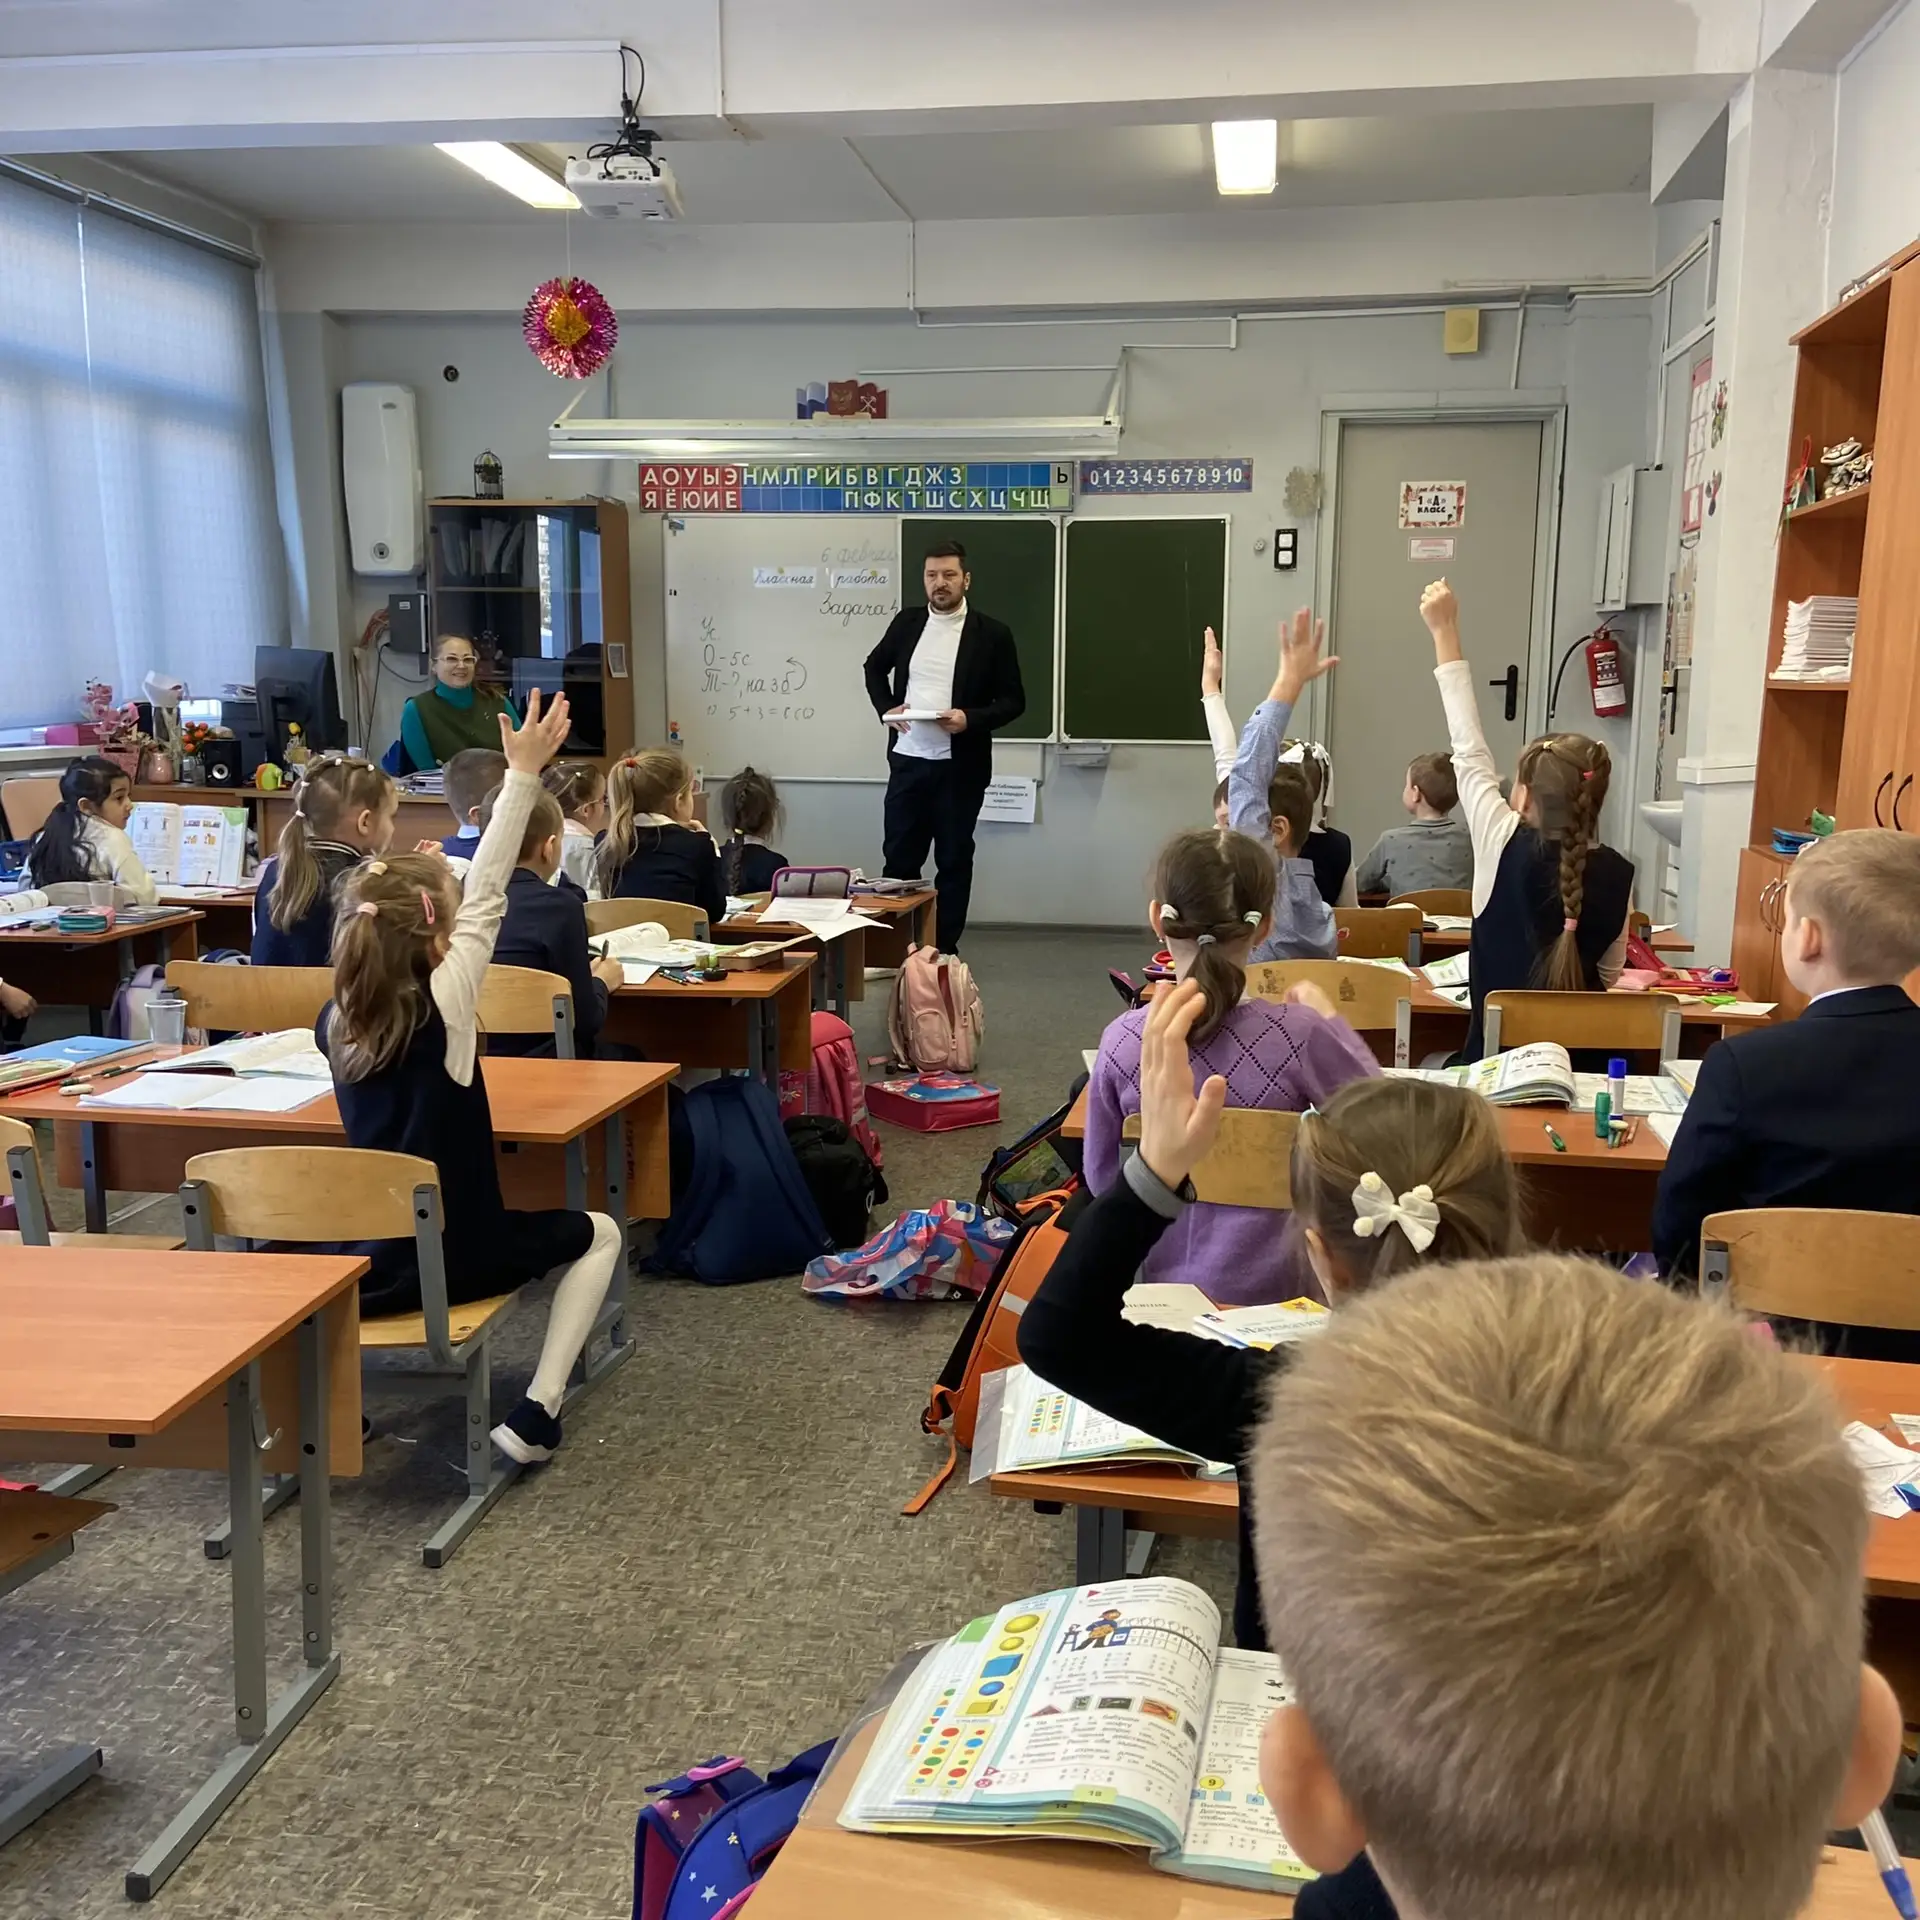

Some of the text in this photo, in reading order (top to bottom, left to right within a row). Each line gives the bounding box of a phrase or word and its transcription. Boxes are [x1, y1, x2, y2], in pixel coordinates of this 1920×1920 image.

[643, 465, 1068, 487] А О У Ы Э Н М Л Р Й Б В Г Д Ж З Ь
[1090, 467, 1242, 485] 0 1 2 3 4 5 6 7 8 9 10
[644, 488, 1050, 510] Я Ё Ю И Е П Ф К Т Ш С Х Ц Ч Щ
[1418, 495, 1423, 505] 1
[820, 547, 831, 563] 6
[834, 568, 889, 588] работа
[819, 592, 888, 627] Задача
